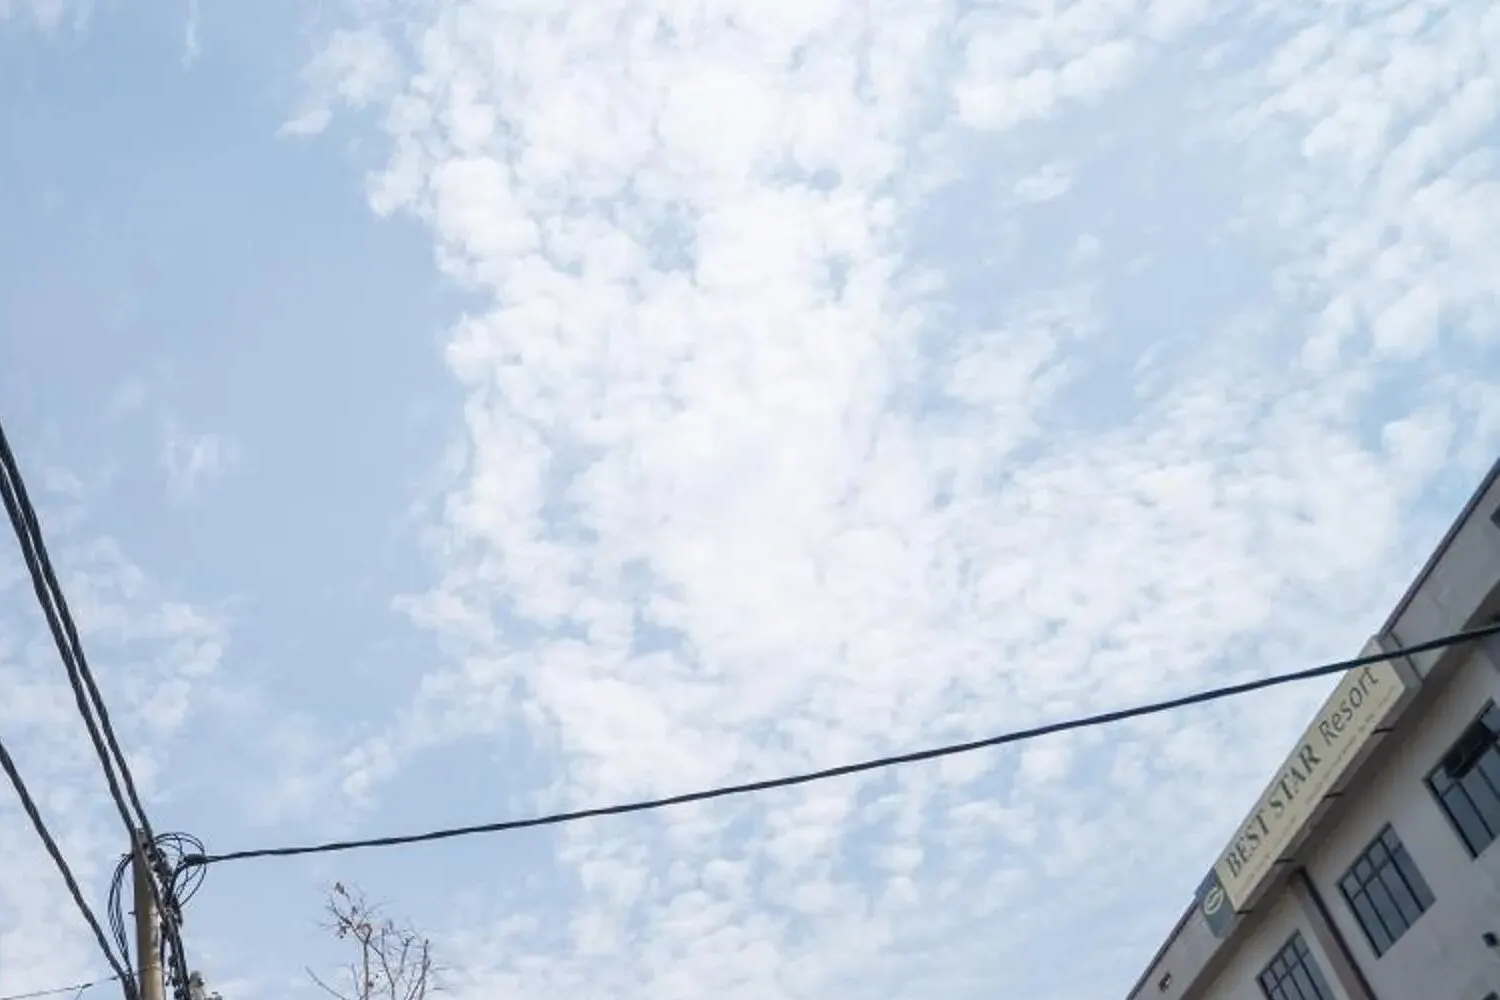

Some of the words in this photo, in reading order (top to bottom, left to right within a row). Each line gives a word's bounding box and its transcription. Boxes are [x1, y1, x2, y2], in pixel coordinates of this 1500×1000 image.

[1224, 811, 1273, 879] BEST
[1268, 743, 1323, 820] STAR
[1318, 666, 1380, 746] Resort
